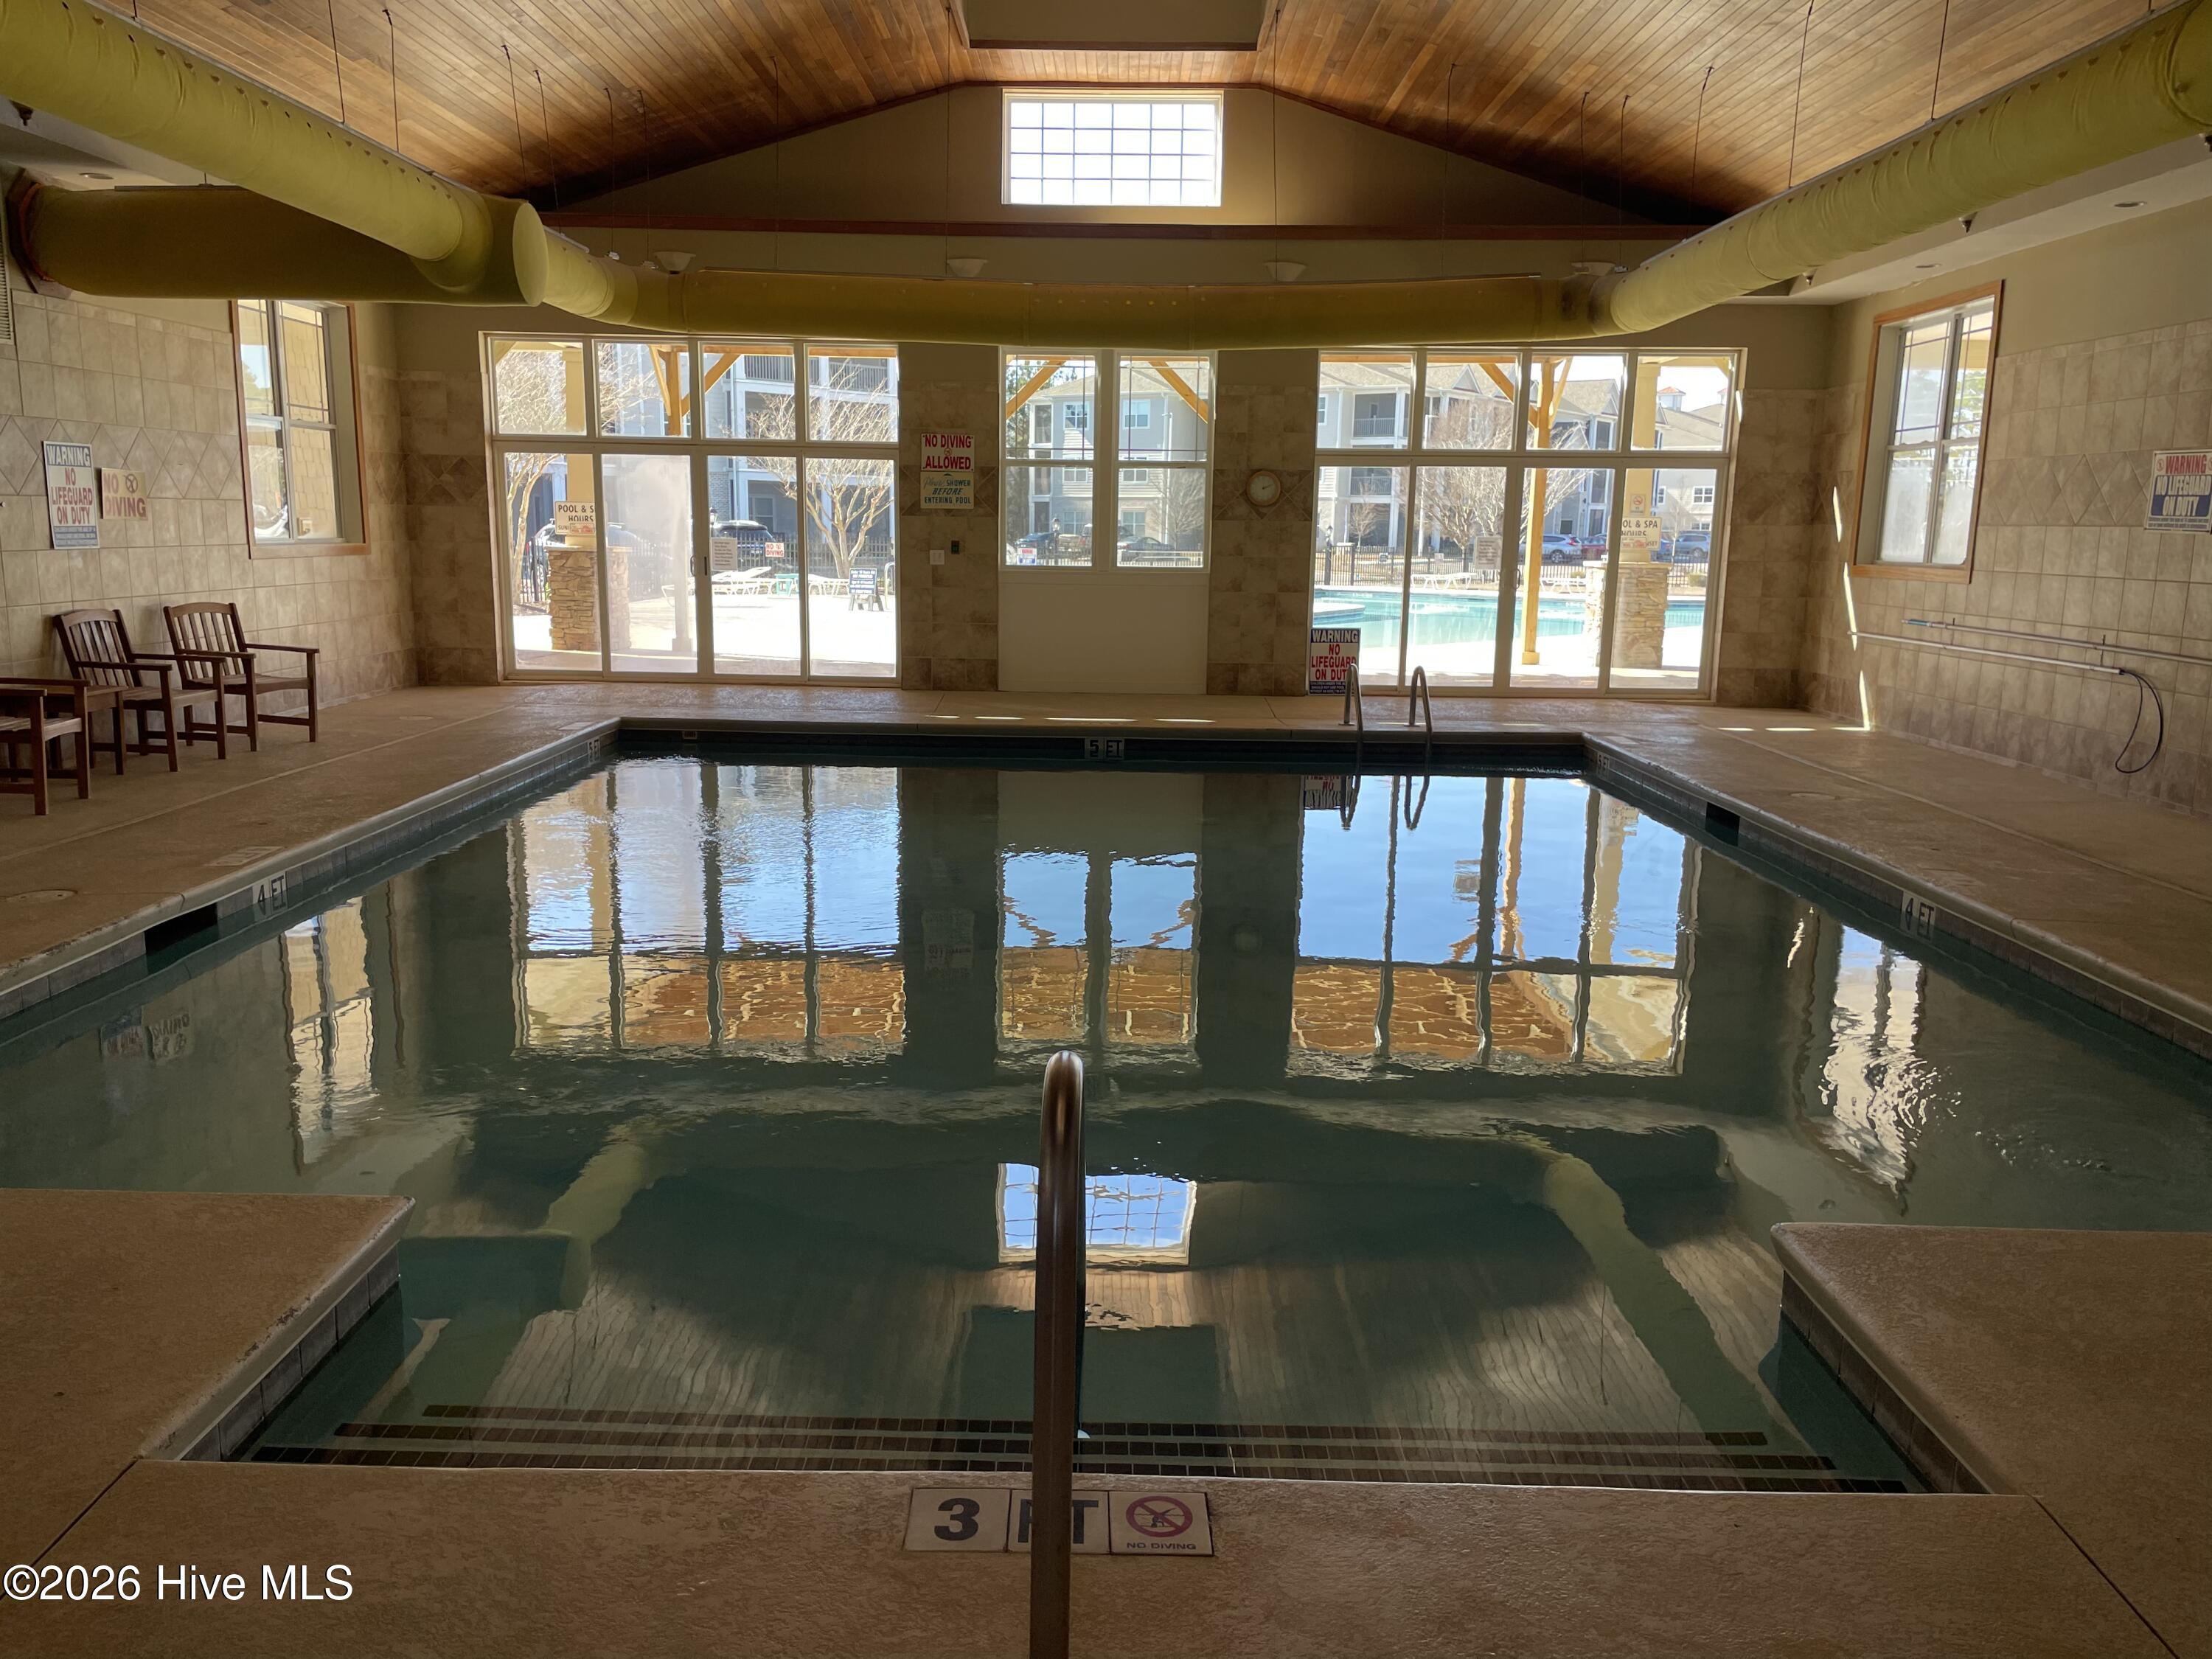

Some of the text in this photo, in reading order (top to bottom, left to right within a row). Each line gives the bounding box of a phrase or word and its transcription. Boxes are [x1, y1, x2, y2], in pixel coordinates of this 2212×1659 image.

[925, 434, 972, 448] NO DIVING
[46, 445, 91, 466] WARNING
[925, 456, 971, 470] ALLOWED
[2166, 454, 2207, 474] WARNING
[65, 467, 76, 485] NO
[103, 472, 119, 493] NO
[2155, 476, 2212, 495] NO LIFEGUARD
[52, 487, 93, 506] LIFEGUARD
[104, 497, 147, 518] DIVING
[558, 504, 578, 513] POOL
[581, 505, 587, 513] &
[2162, 496, 2199, 516] ON DUTY
[57, 507, 91, 524] ON DUTY
[1635, 520, 1641, 528] &
[1644, 520, 1658, 529] SPA
[1312, 630, 1358, 642] WARNING
[1329, 644, 1340, 655] NO
[1311, 656, 1357, 668] LIFEGUARD
[1315, 669, 1348, 681] ON DUT
[933, 1498, 980, 1542] 3
